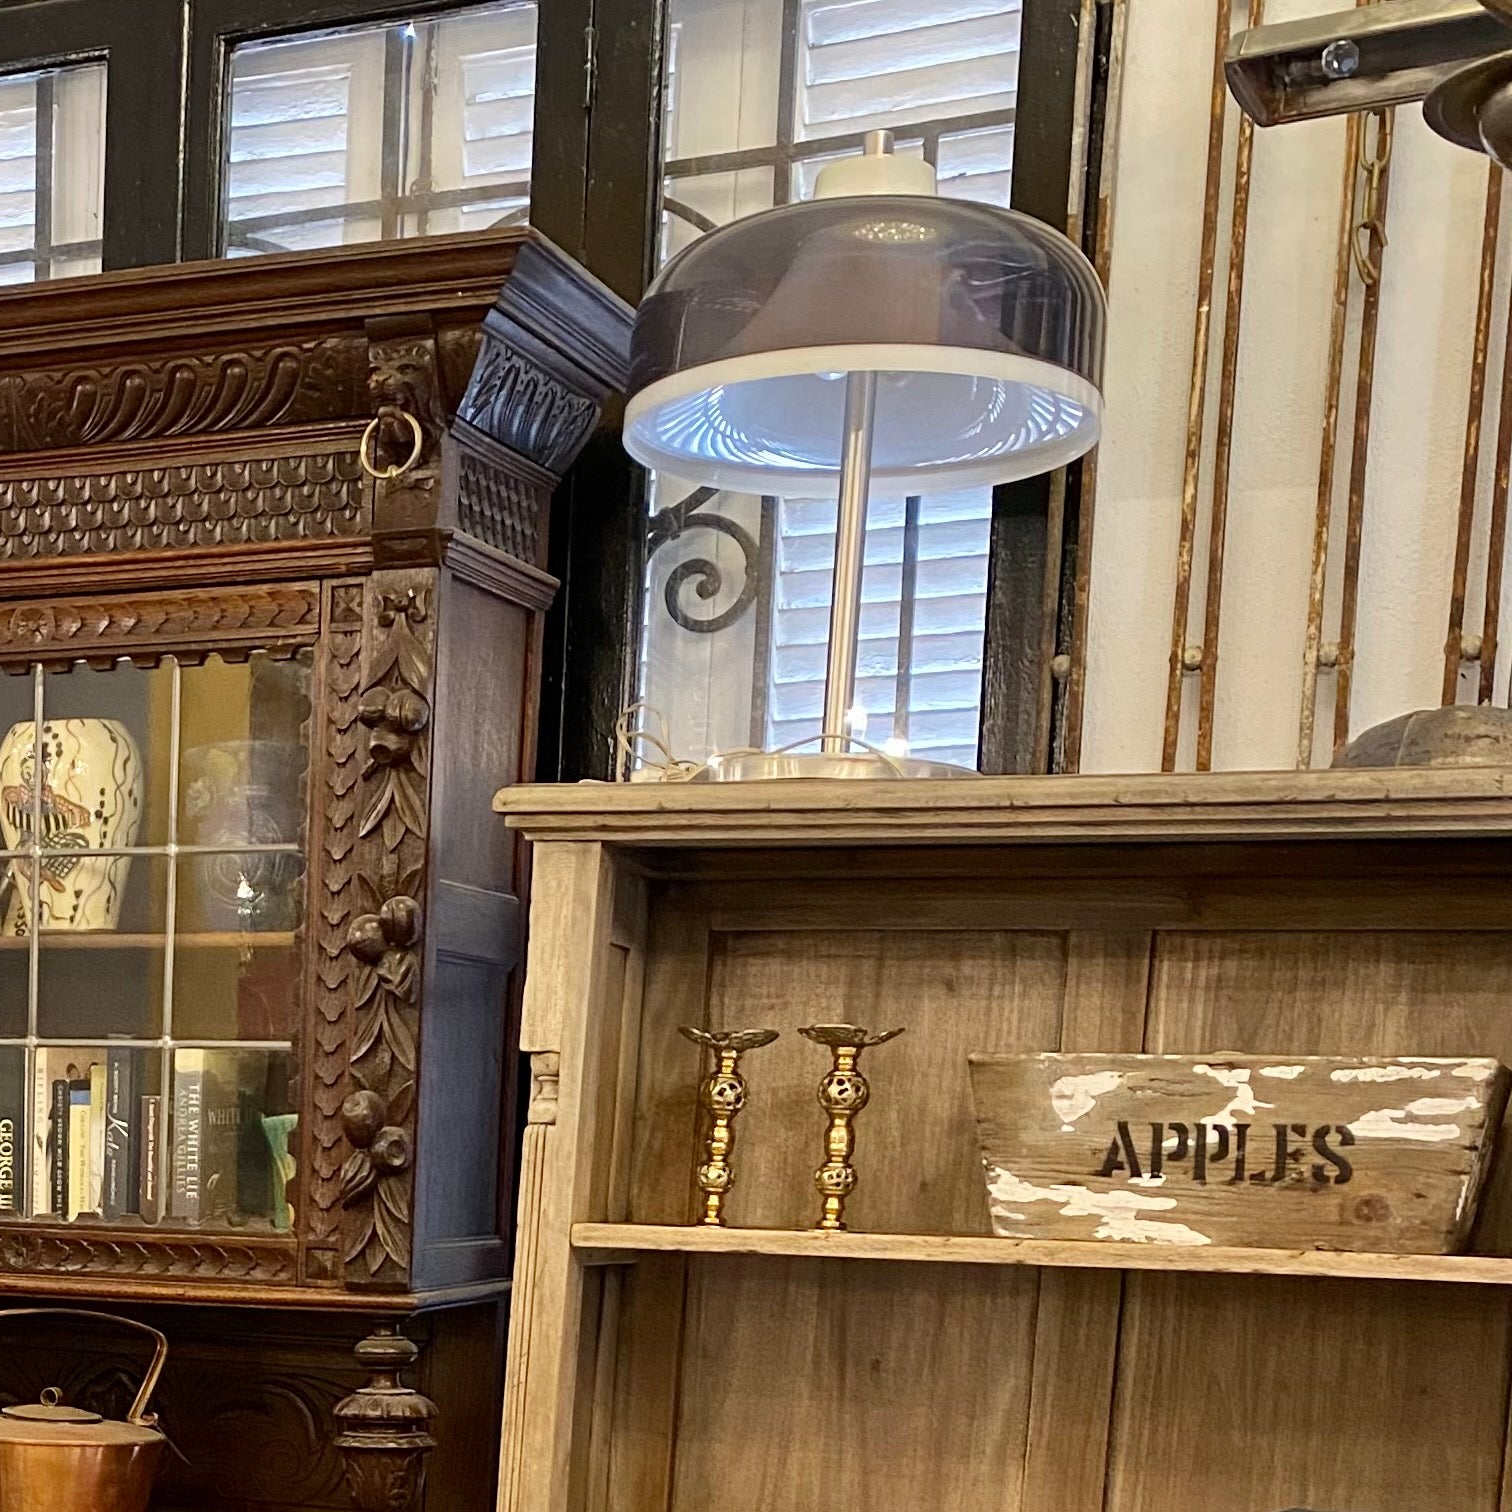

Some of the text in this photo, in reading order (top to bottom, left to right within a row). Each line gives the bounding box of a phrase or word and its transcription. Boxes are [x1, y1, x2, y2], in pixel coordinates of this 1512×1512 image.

[0, 1118, 13, 1209] GEORGE III
[105, 1102, 128, 1156] Kate
[176, 1088, 186, 1193] ANDREA GILLIES
[185, 1084, 199, 1199] THE WHITE LIE
[1097, 1120, 1356, 1186] APPLES
